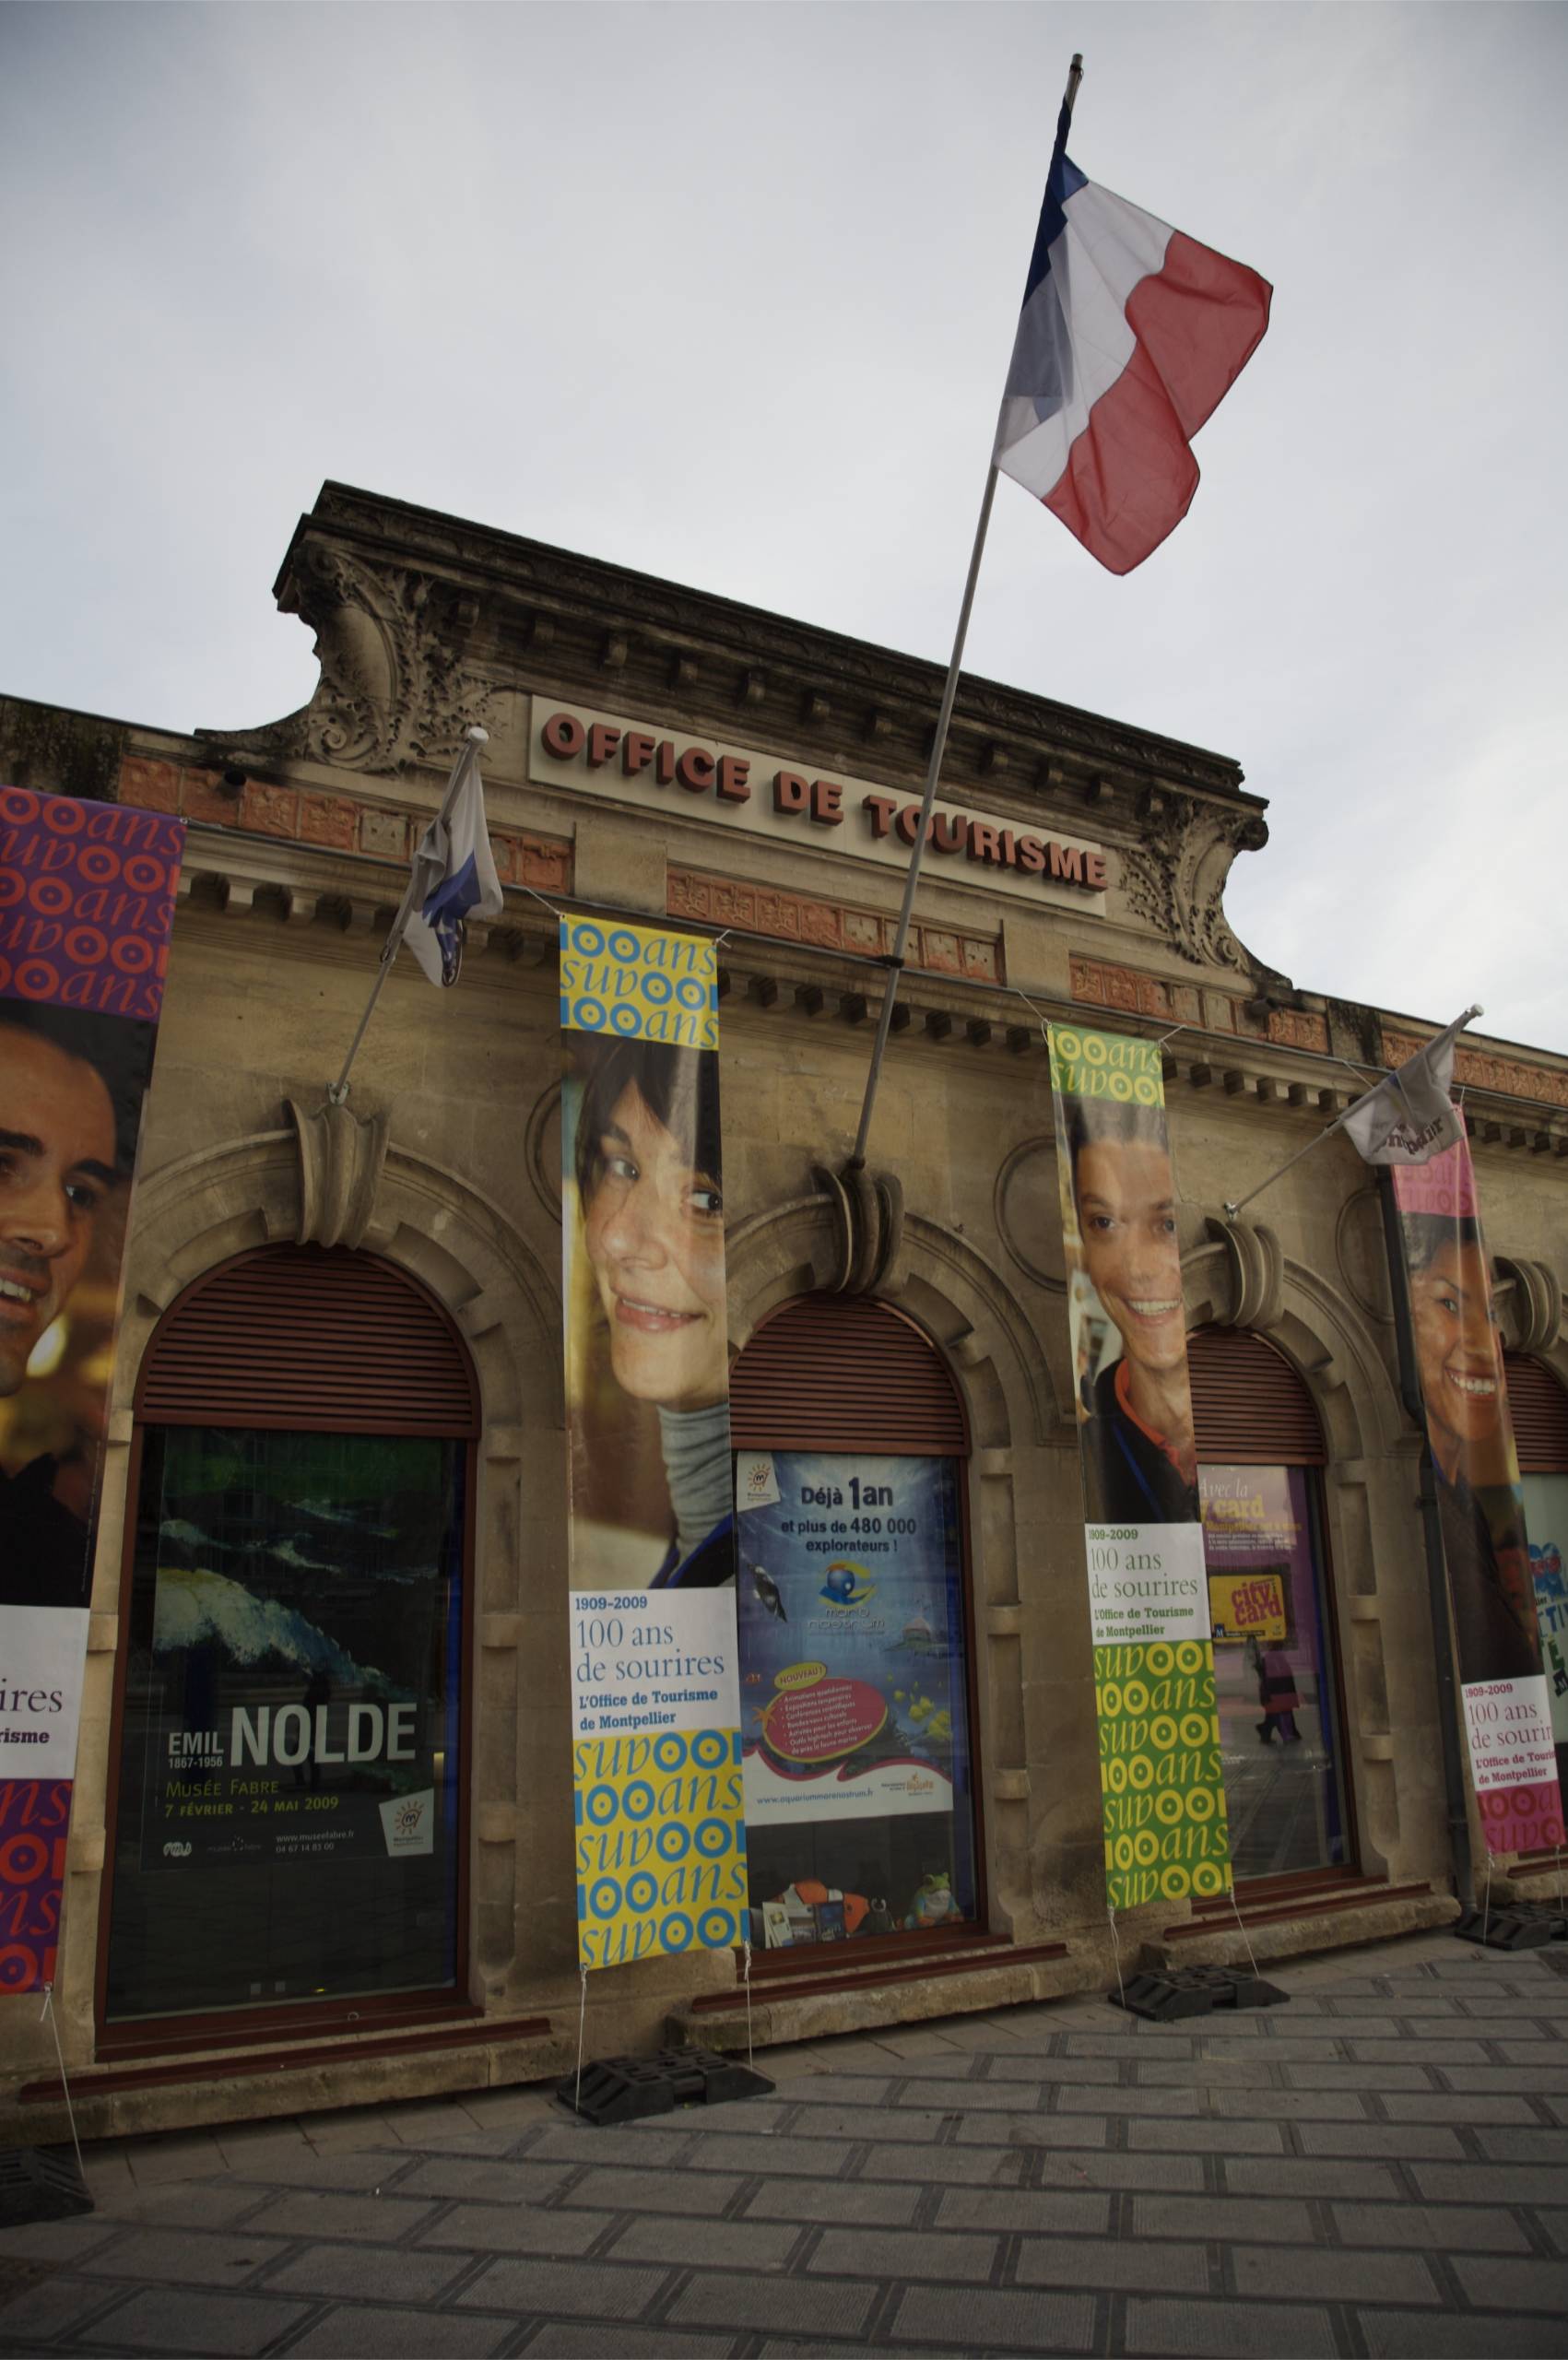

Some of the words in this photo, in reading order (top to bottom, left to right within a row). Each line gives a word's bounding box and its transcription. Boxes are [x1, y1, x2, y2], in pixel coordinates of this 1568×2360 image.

[541, 713, 750, 804] OFFICE
[772, 770, 843, 826] DE
[862, 795, 1107, 892] TOURISME
[801, 1486, 843, 1509] Déjà
[1236, 1477, 1248, 1498] la
[1213, 1493, 1267, 1519] card
[781, 1519, 794, 1533] et
[798, 1520, 827, 1535] plus
[831, 1520, 847, 1534] de
[851, 1517, 881, 1534] 480
[887, 1518, 916, 1534] 000
[1089, 1528, 1138, 1540] 1909-2009
[806, 1539, 890, 1554] explorateurs
[1091, 1547, 1119, 1572] 100
[1126, 1553, 1162, 1571] ans
[1091, 1574, 1107, 1599] de
[1114, 1572, 1198, 1599] sourires
[1232, 1580, 1270, 1609] city
[575, 1595, 647, 1611] 1909-2009
[1127, 1607, 1141, 1619] de
[1144, 1606, 1194, 1619] Tourisme
[1235, 1592, 1283, 1625] card
[577, 1618, 623, 1649] 100
[631, 1623, 674, 1647] ans
[1096, 1627, 1104, 1638] de
[1106, 1624, 1165, 1638] Montpellier
[576, 1652, 607, 1683] de
[616, 1648, 725, 1682] sourires
[780, 1666, 819, 1684] NOUVEAU
[579, 1693, 628, 1709] L'Office
[631, 1692, 648, 1705] de
[652, 1688, 719, 1704] Tourisme
[1466, 1682, 1514, 1699] 1909-2009
[580, 1717, 595, 1731] de
[599, 1711, 677, 1730] Montpellier
[1468, 1702, 1499, 1726] 100
[1504, 1703, 1538, 1722] ans
[169, 1730, 224, 1756] EMIL
[230, 1702, 418, 1767] NOLDE
[1471, 1728, 1491, 1751] de
[168, 1755, 223, 1770] 1867-1956
[1513, 1753, 1525, 1764] de
[1479, 1774, 1490, 1786] de
[1492, 1766, 1548, 1784] Montpellier
[165, 1803, 173, 1818] 7
[180, 1802, 233, 1816] FÉVRIER
[251, 1799, 268, 1814] 24
[274, 1799, 300, 1812] MAI
[304, 1795, 339, 1811] 2009
[276, 1829, 354, 1843] www.museefabre.fr
[276, 1844, 286, 1853] 04
[288, 1844, 299, 1853] 67
[301, 1843, 311, 1852] 14
[324, 1842, 335, 1851] 00
